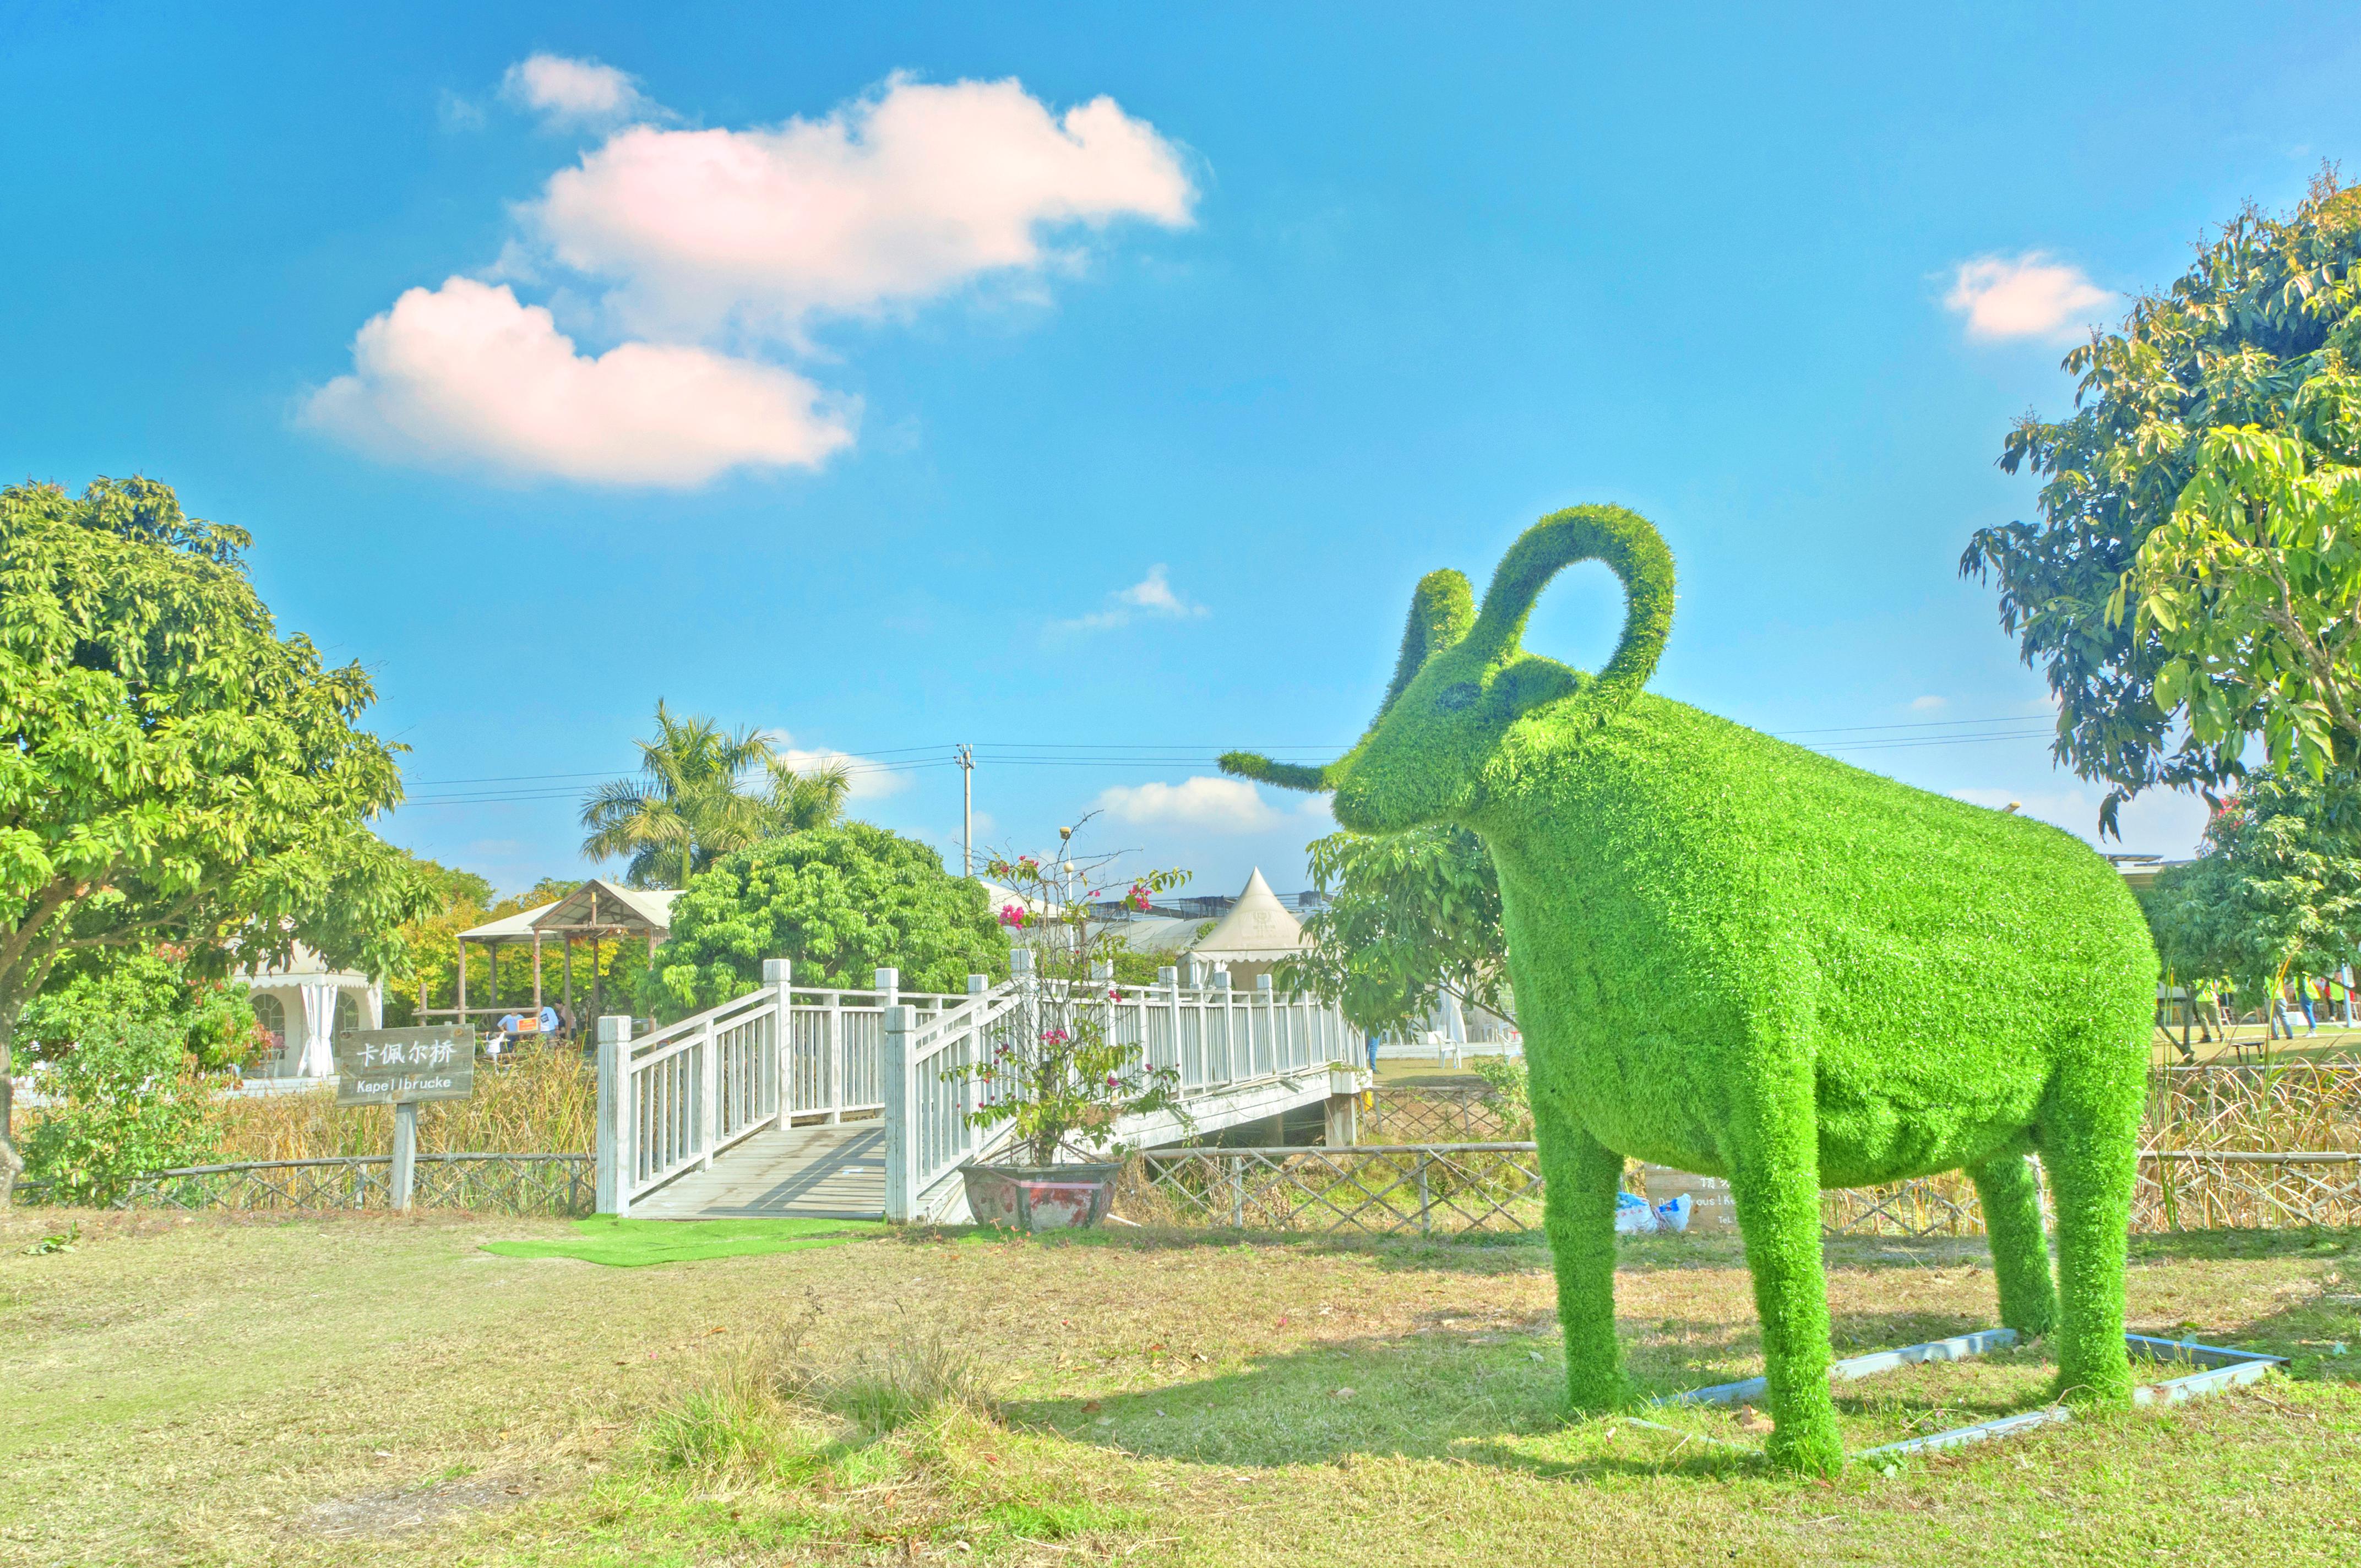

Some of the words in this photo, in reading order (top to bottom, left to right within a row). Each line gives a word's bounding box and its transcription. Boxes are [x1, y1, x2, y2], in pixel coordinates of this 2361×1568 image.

[356, 1039, 458, 1067] 卡佩尔桥
[357, 1075, 451, 1093] Kapellbrucke
